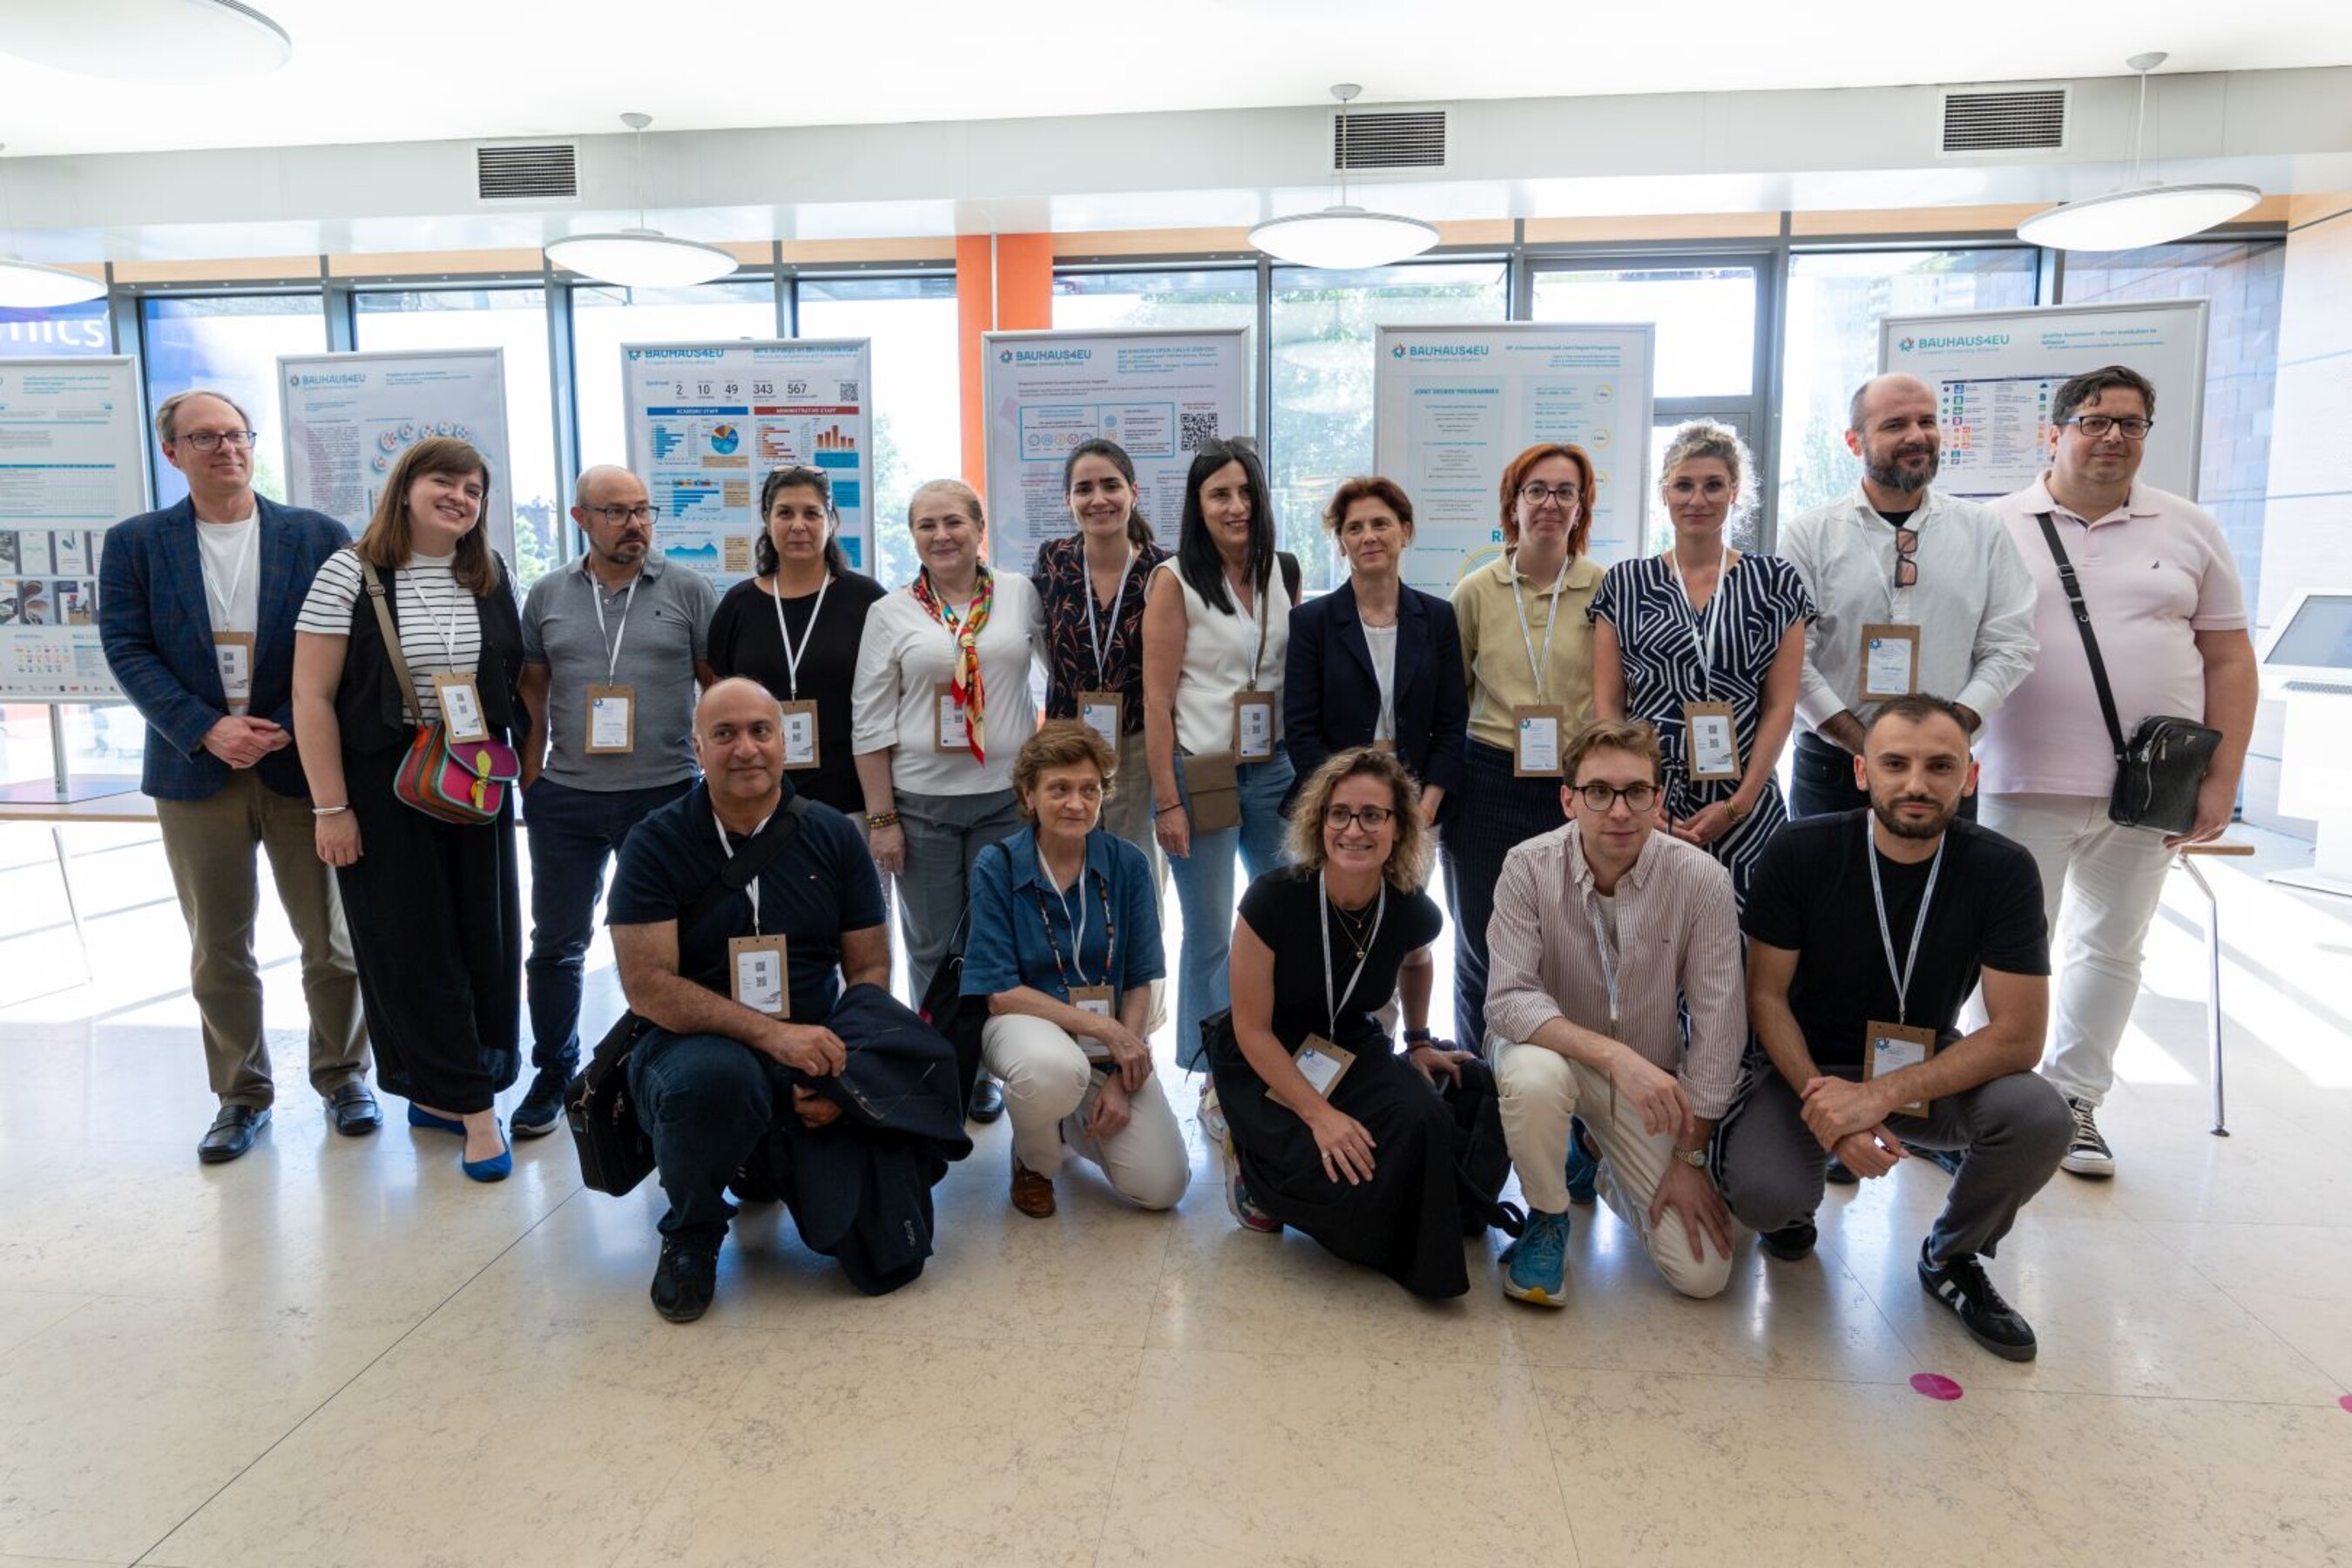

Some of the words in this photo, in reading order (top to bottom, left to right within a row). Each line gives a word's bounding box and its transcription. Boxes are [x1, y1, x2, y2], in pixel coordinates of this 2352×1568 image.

[1918, 335, 2010, 349] BAUHAUS4EU
[645, 348, 724, 358] BAUHAUS4EU
[1016, 349, 1092, 361] BAUHAUS4EU
[1409, 346, 1489, 356] BAUHAUS4EU
[302, 373, 366, 385] BAUHAUS4EU
[676, 384, 683, 395] 2
[698, 384, 710, 395] 10
[725, 384, 738, 395] 49
[753, 383, 774, 395] 343
[787, 383, 807, 394] 567
